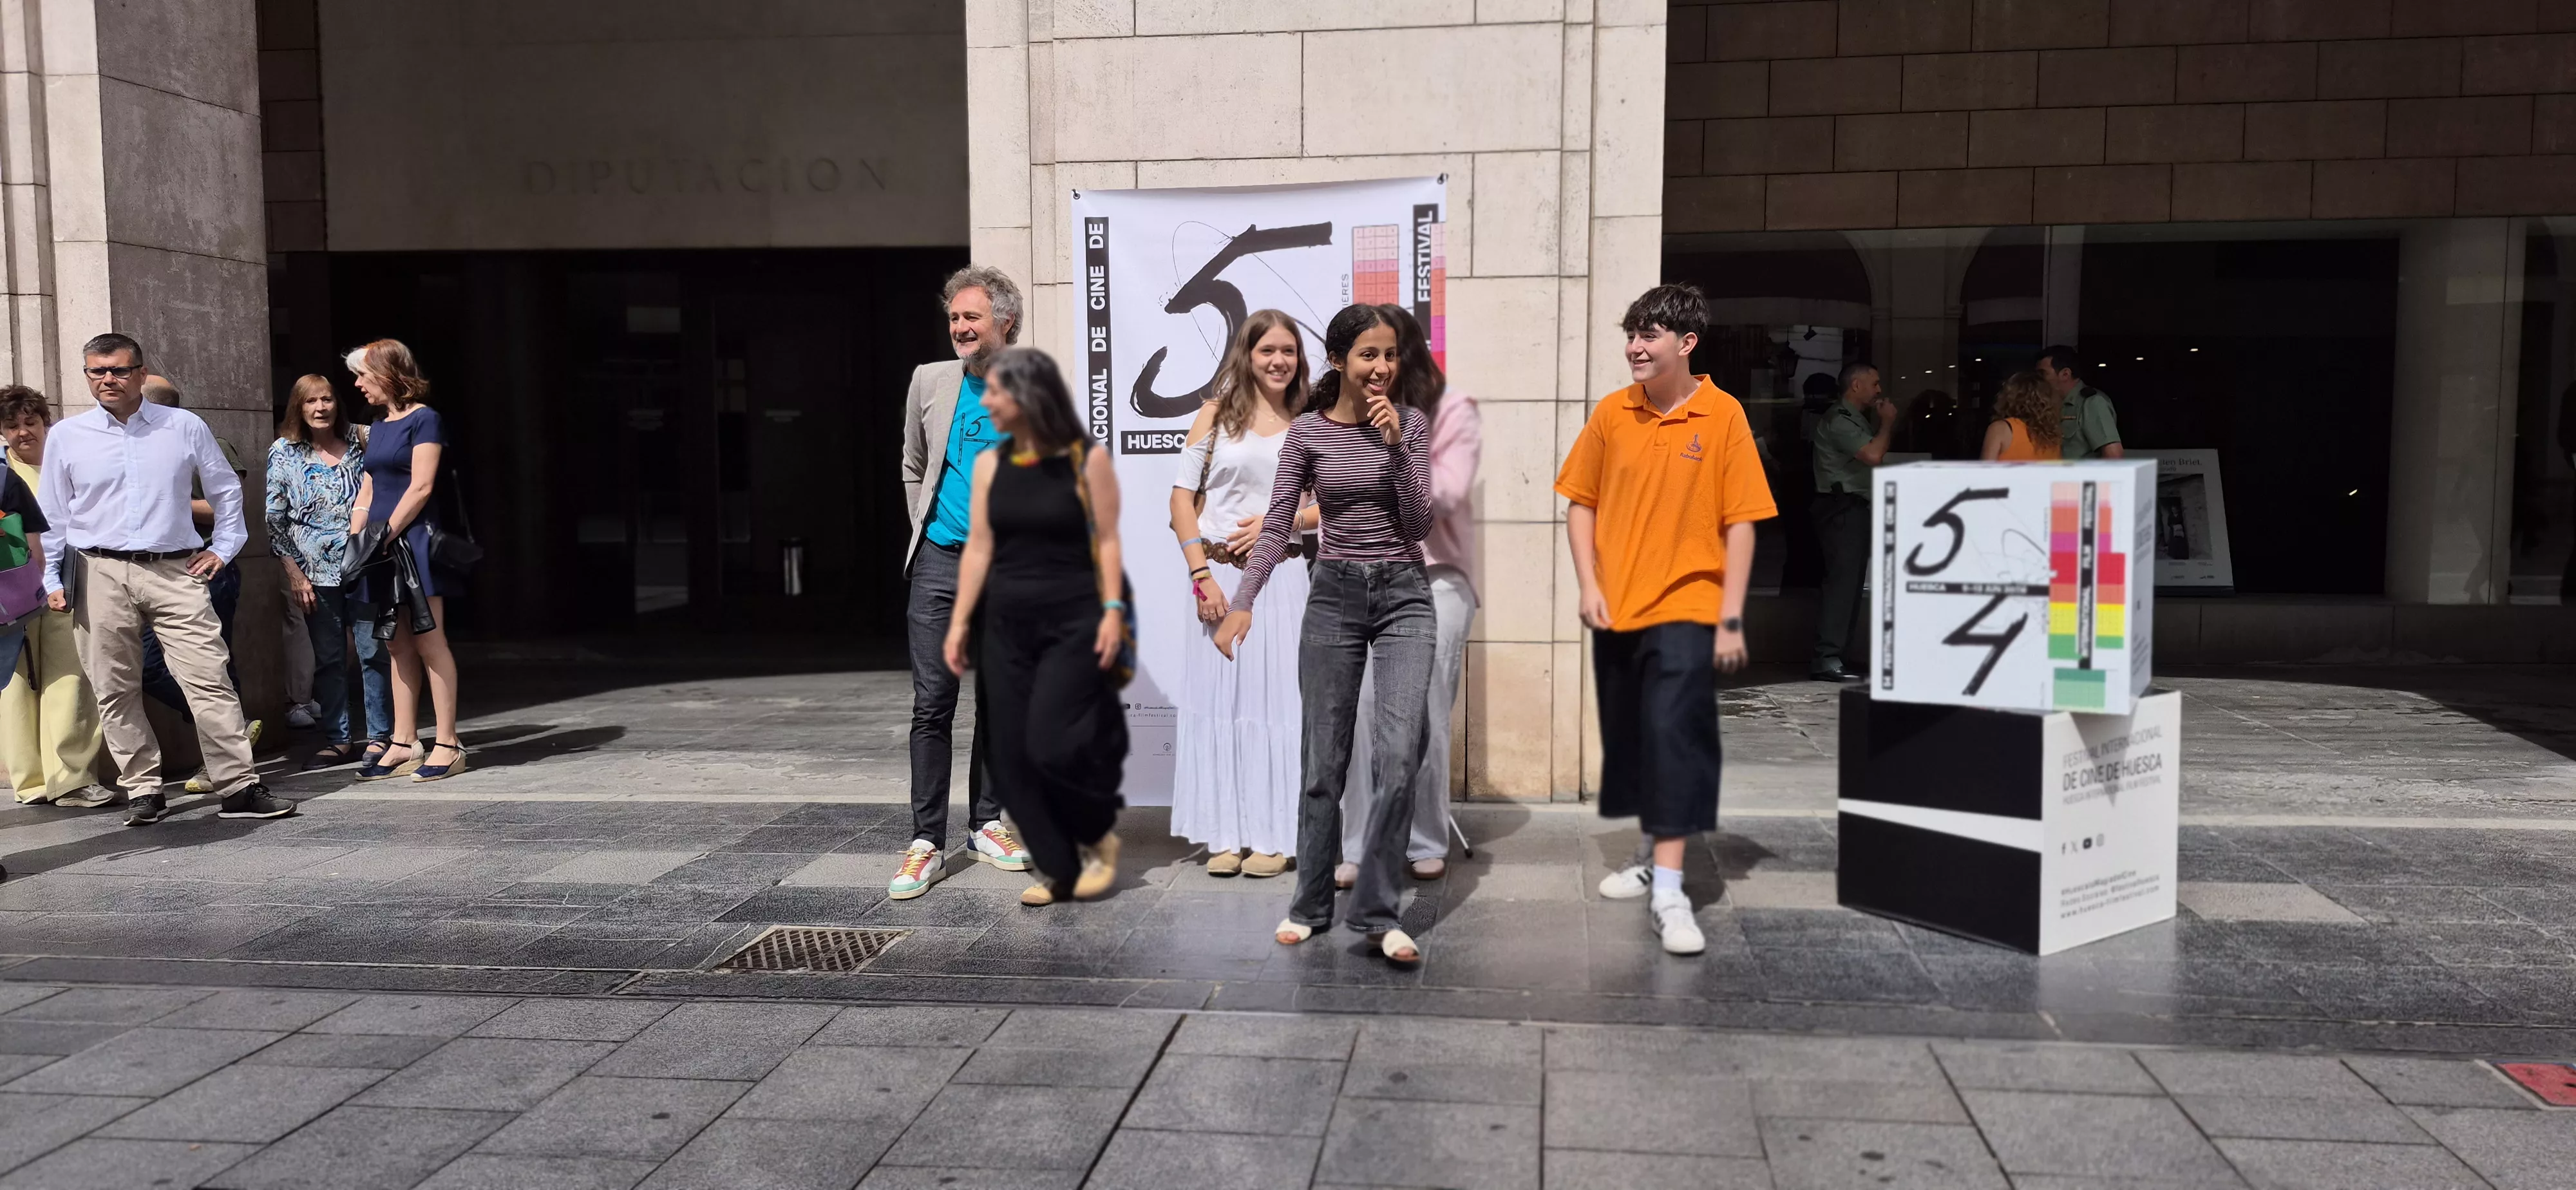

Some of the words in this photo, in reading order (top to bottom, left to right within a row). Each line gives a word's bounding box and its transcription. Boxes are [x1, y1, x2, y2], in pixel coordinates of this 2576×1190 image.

[522, 156, 888, 194] DIPUTACION
[1088, 223, 1104, 249] DE
[1417, 210, 1433, 302] FESTIVAL
[1090, 265, 1106, 310] CINE
[1092, 326, 1107, 352] DE
[1130, 221, 1333, 419] 5
[1092, 368, 1108, 444] CIONAL
[1128, 433, 1186, 449] HUESC
[1903, 487, 2009, 577] 5
[1942, 594, 2029, 696] 4
[2063, 744, 2100, 769] FESTIVAL
[2101, 725, 2163, 755] INTERNACIONAL
[2063, 771, 2077, 791] DE
[2080, 765, 2104, 788] CINE
[2107, 761, 2120, 782] DE
[2122, 753, 2163, 777] HUESCA
